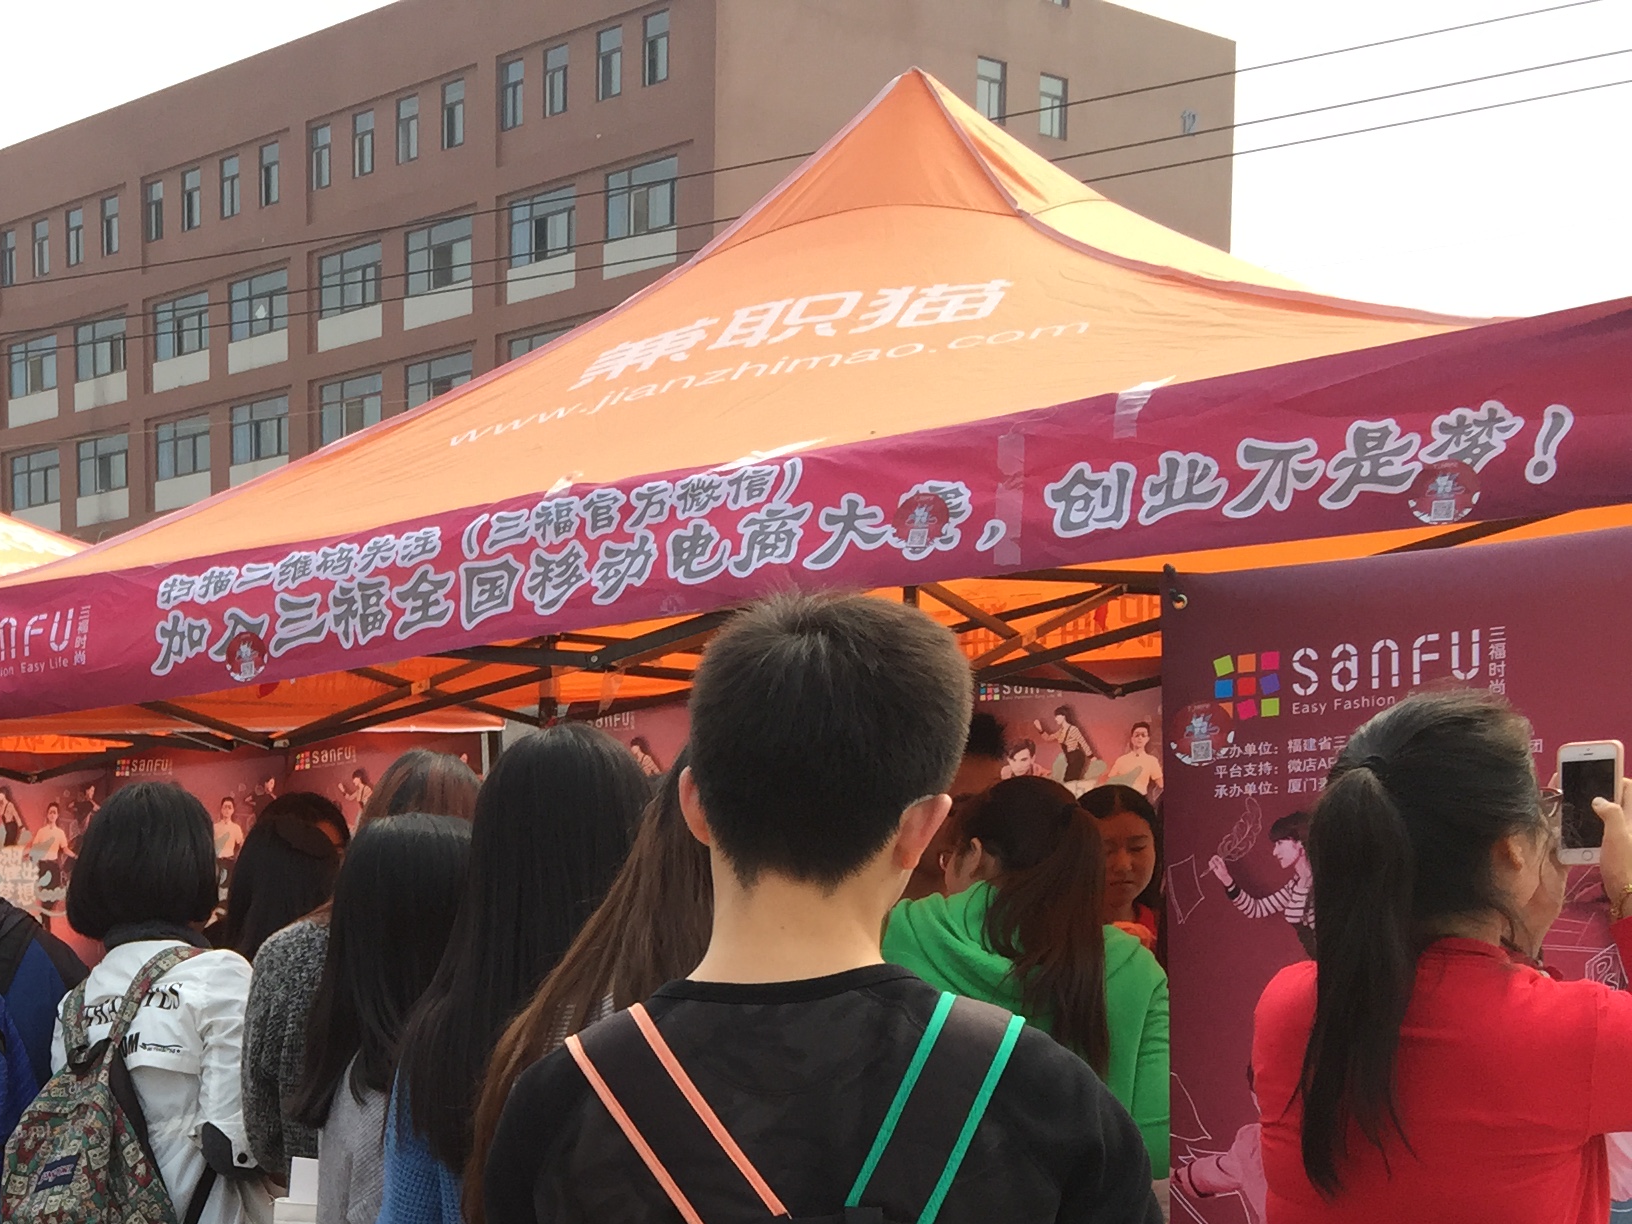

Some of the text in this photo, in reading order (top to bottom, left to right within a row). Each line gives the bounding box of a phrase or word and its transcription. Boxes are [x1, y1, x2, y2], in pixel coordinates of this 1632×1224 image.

[567, 279, 1014, 392] 兼职猫
[449, 320, 1091, 447] www.jianzhimao.com
[21, 661, 46, 675] Easy
[49, 656, 70, 670] Life
[1488, 625, 1507, 696] 三福时尚
[1292, 693, 1396, 716] Easy Fashion
